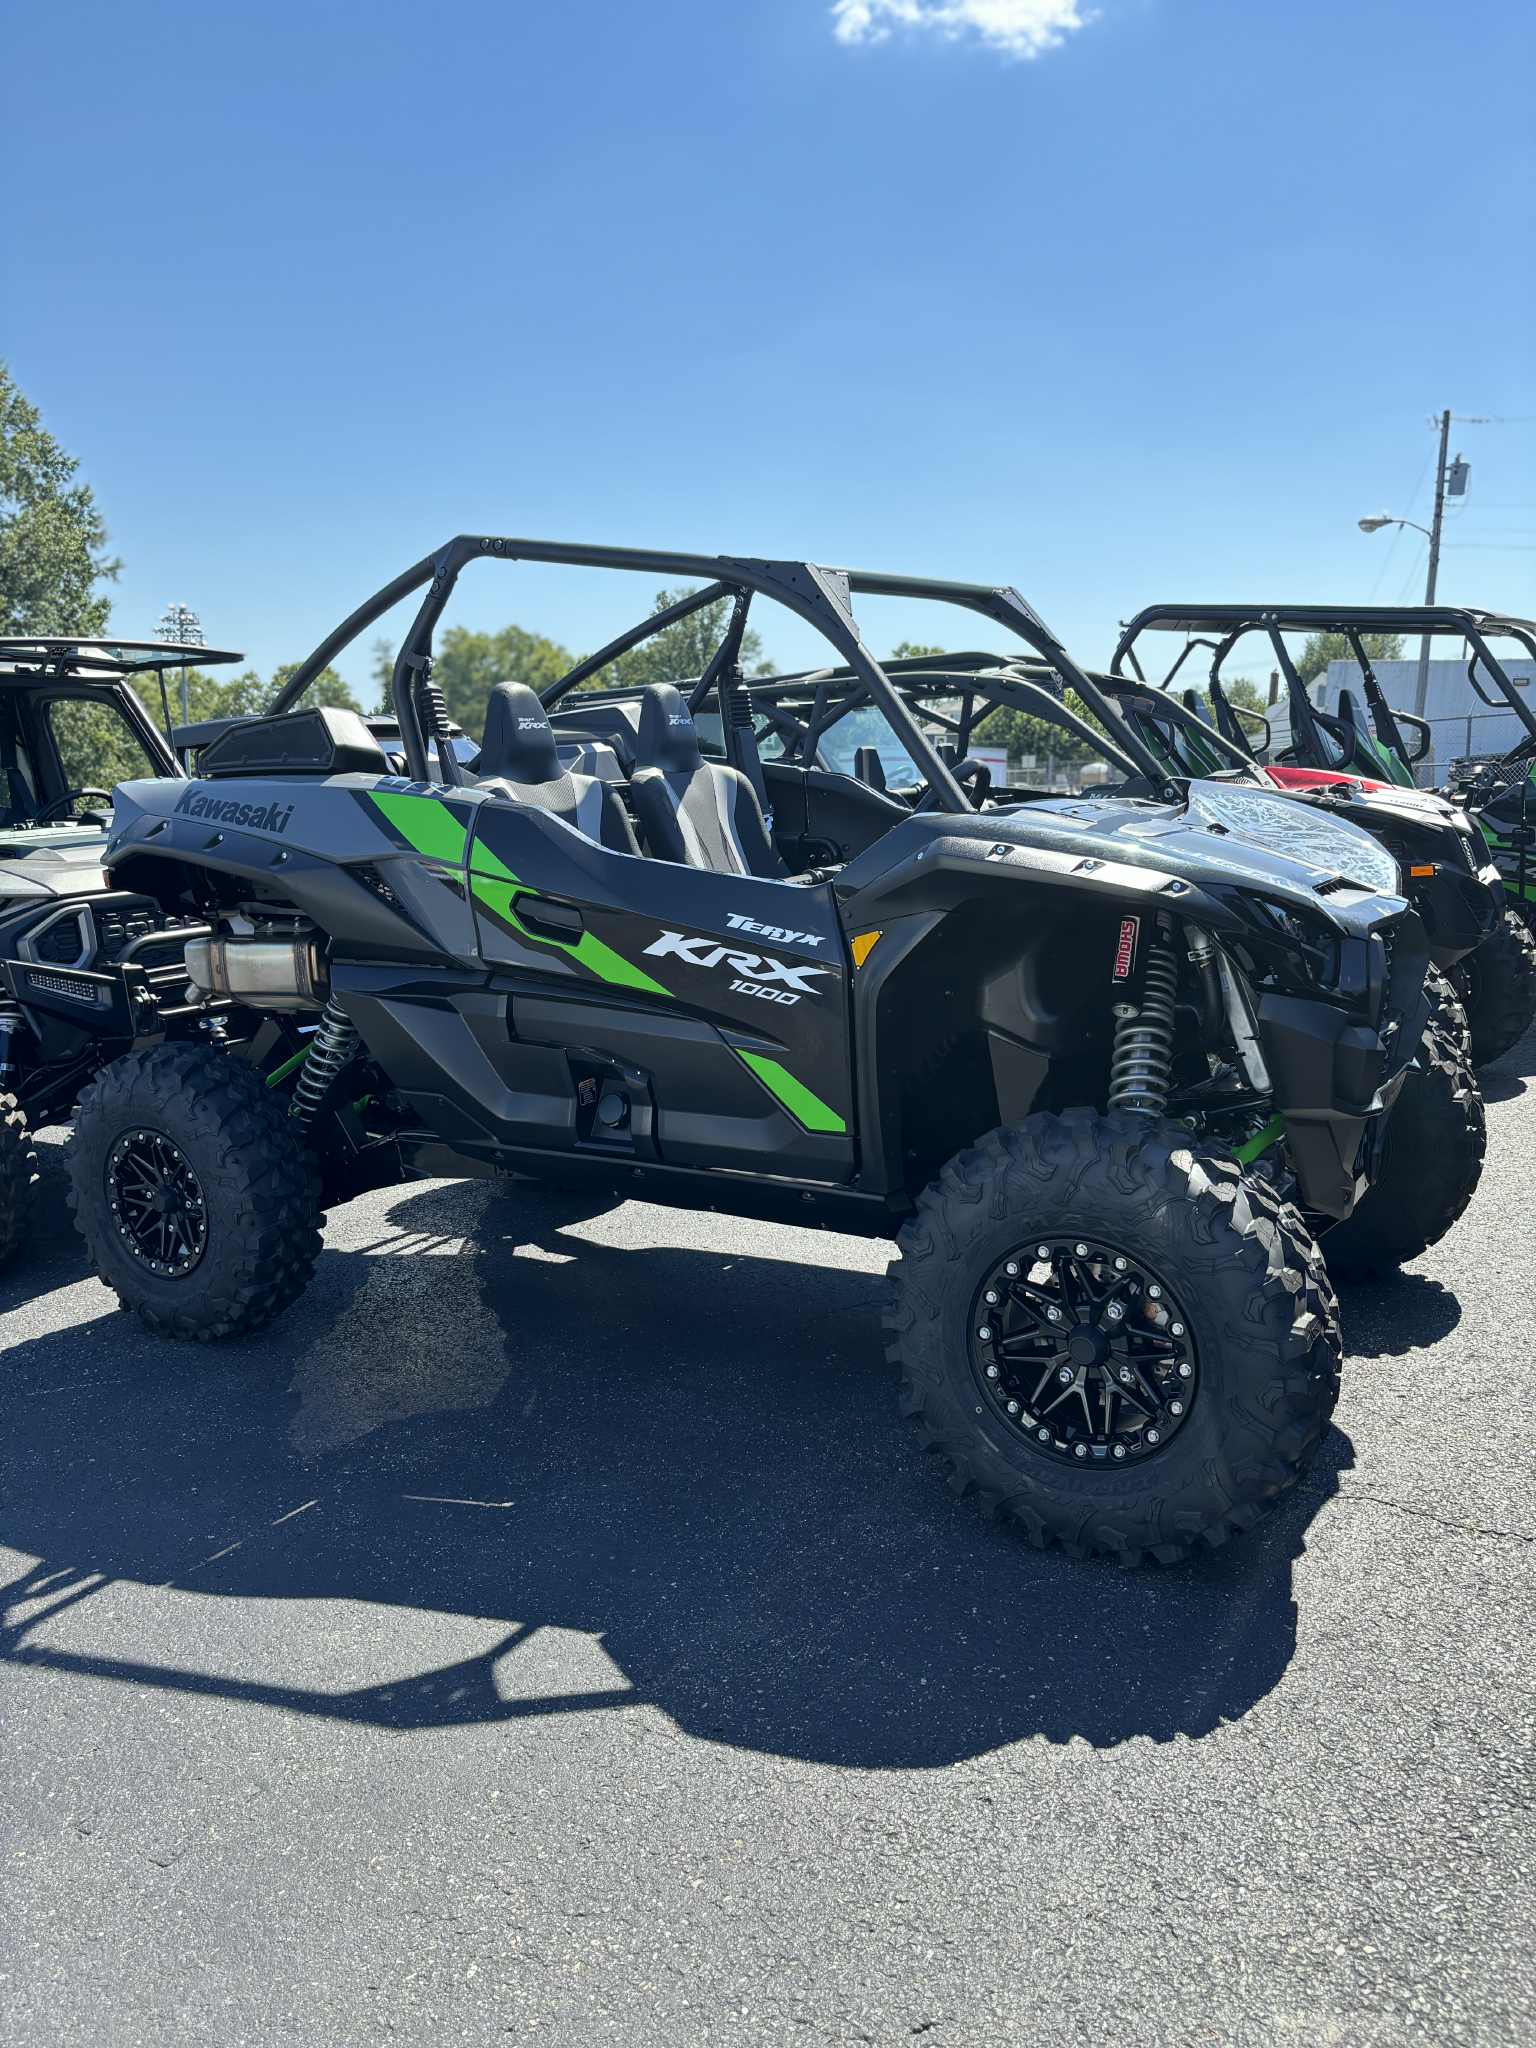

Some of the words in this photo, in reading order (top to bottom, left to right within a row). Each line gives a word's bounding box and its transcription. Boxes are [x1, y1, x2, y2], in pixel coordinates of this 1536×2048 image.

[173, 789, 296, 834] Kawasaki
[726, 913, 827, 946] TERYX
[1114, 920, 1135, 978] SHOWA
[642, 929, 831, 996] KRX
[728, 979, 801, 1006] 1000
